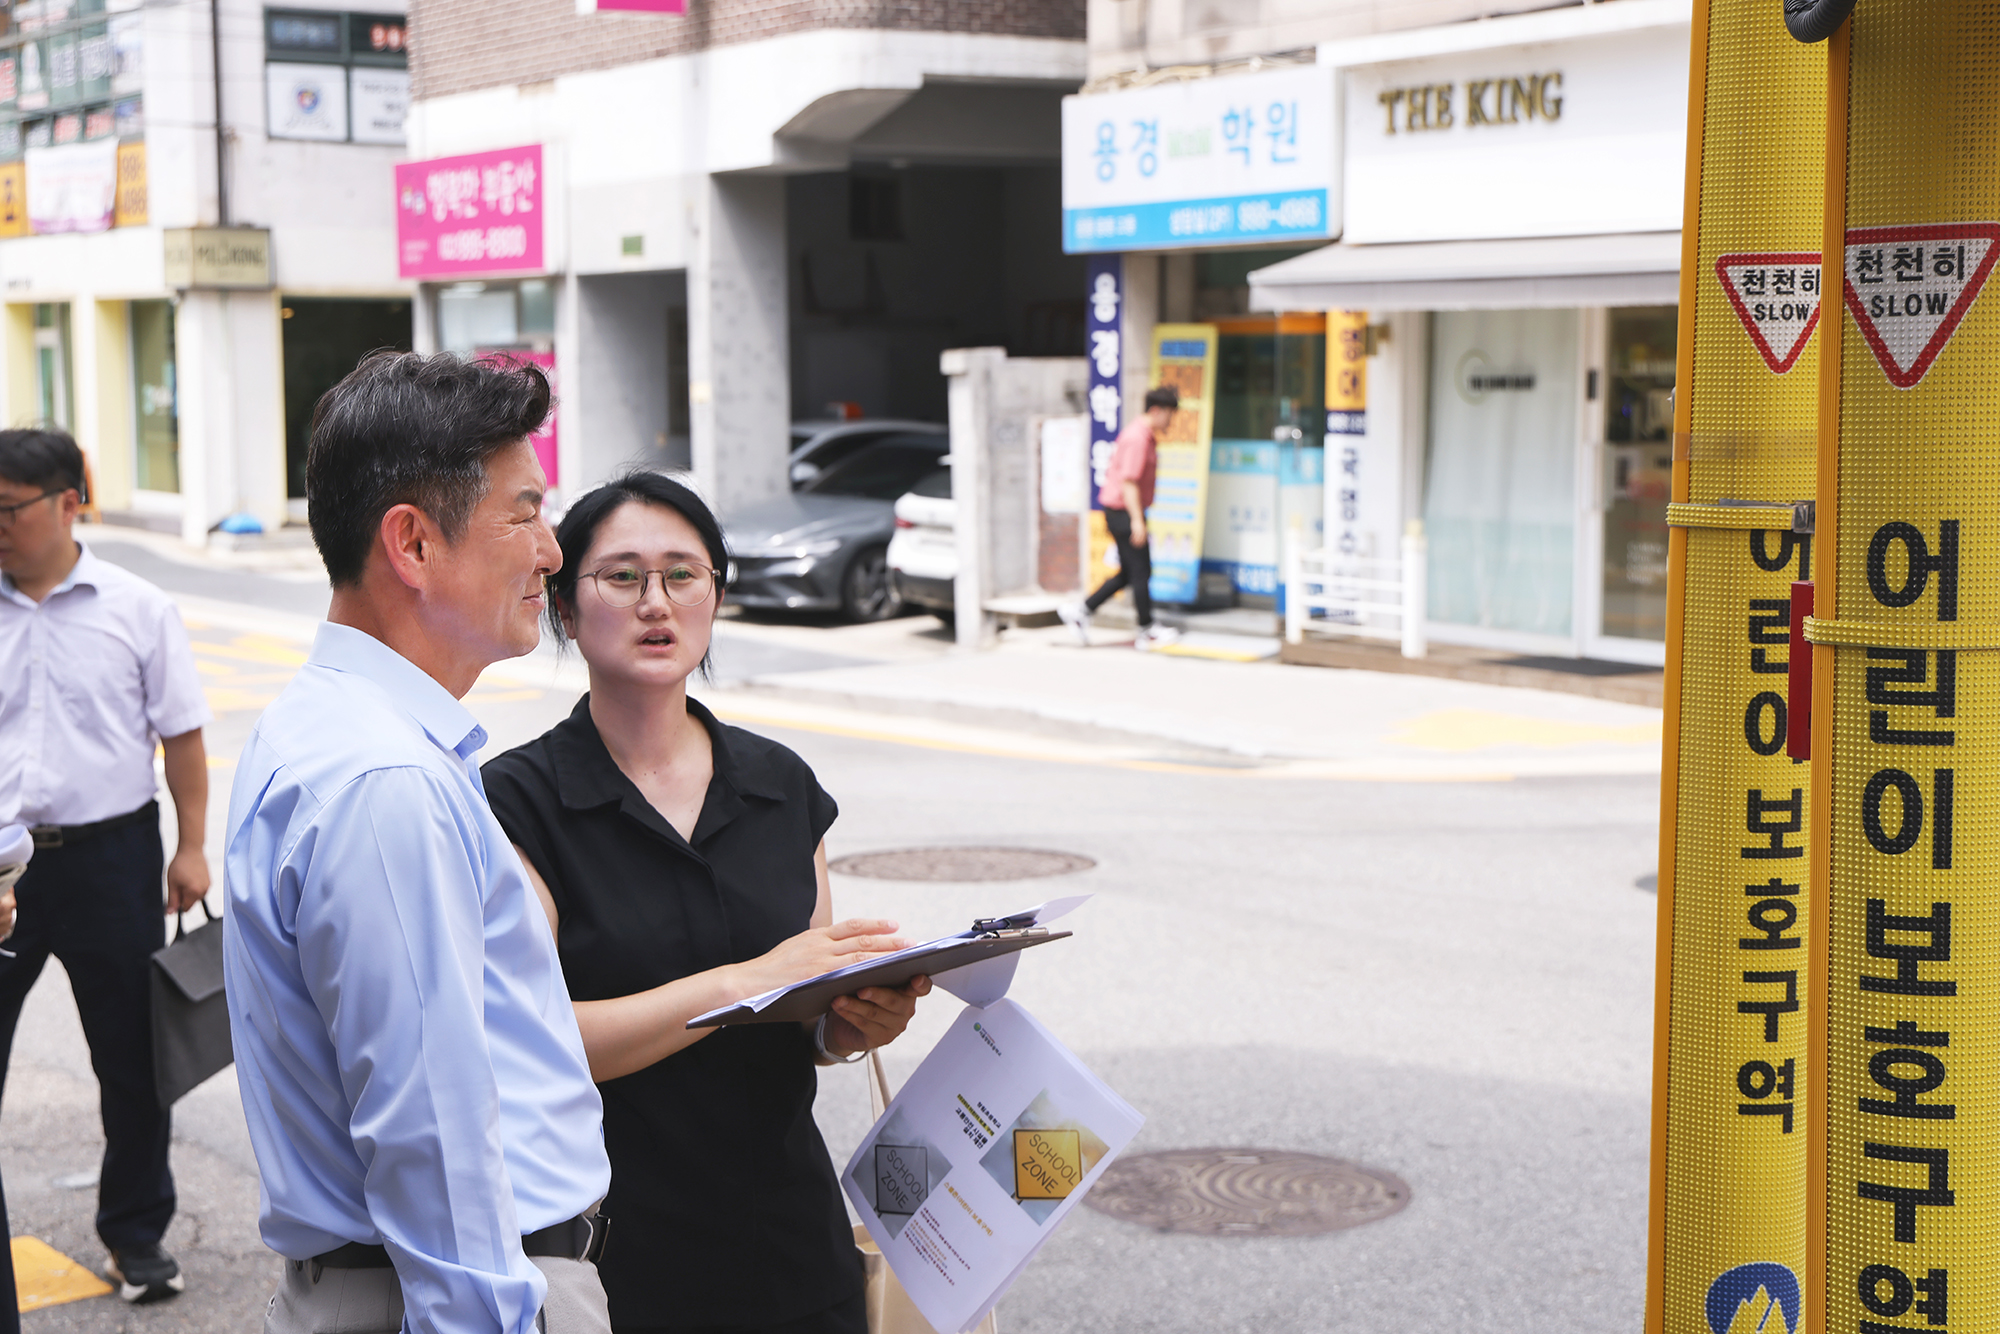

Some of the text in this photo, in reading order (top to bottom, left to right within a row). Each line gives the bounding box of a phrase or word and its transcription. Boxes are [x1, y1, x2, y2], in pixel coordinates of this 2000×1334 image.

[1379, 72, 1563, 134] THE KING
[1094, 120, 1159, 182] 용경
[1222, 101, 1298, 165] 학원
[1741, 269, 1820, 297] 천천히
[1855, 244, 1966, 285] 천천히
[1753, 302, 1811, 323] SLOW
[1870, 292, 1949, 319] SLOW
[886, 1149, 925, 1202] SCHOOL
[1021, 1156, 1059, 1194] ZONE
[1029, 1134, 1078, 1186] SCHOOL
[881, 1171, 909, 1209] ZONE
